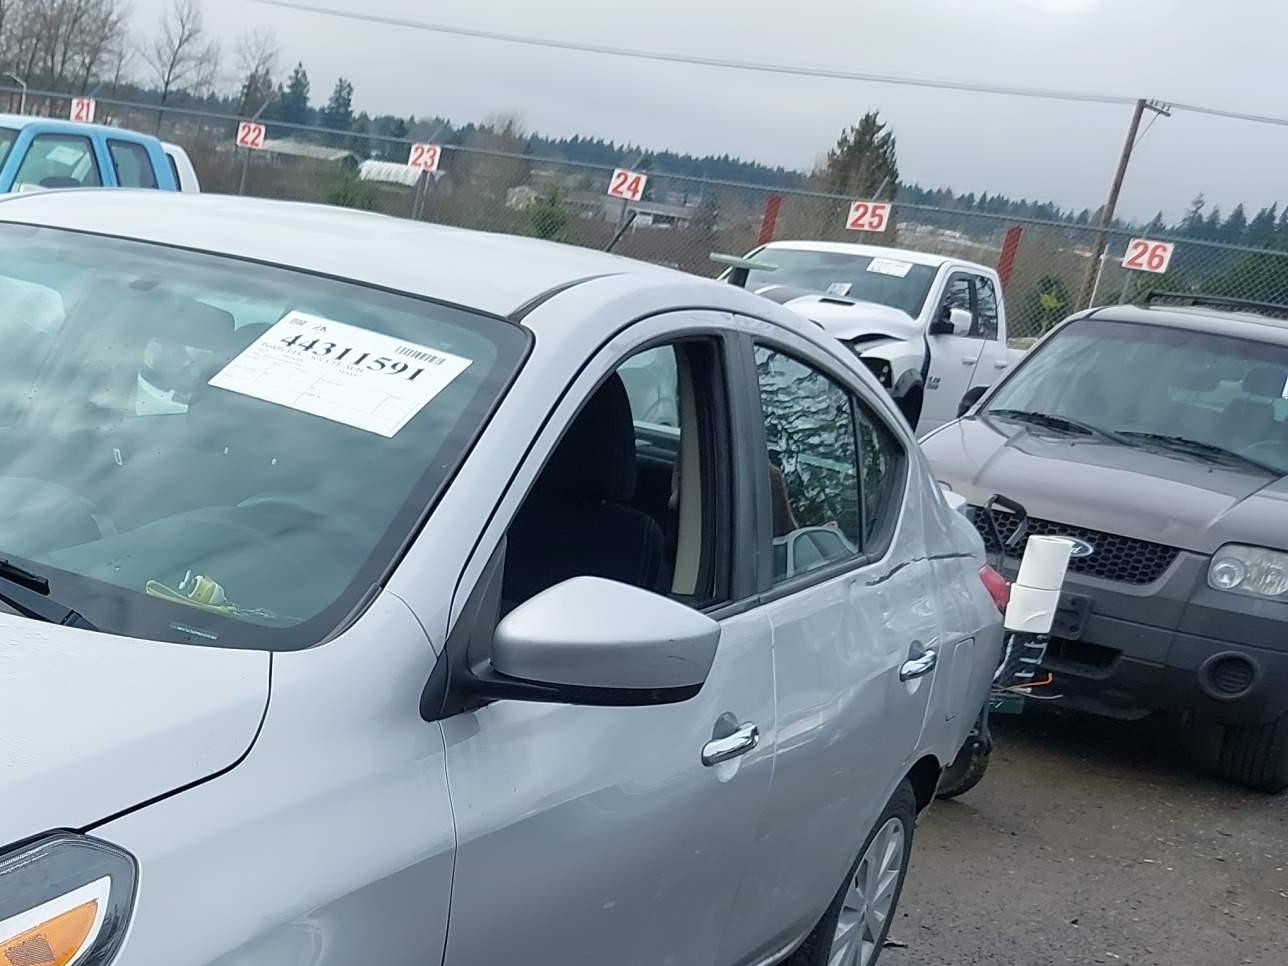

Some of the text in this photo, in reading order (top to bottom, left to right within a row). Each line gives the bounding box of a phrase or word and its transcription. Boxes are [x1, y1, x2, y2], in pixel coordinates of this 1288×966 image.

[74, 101, 91, 120] 21
[240, 123, 262, 147] 22
[410, 145, 437, 168] 23
[611, 171, 642, 198] 24
[849, 203, 886, 230] 25
[1127, 241, 1168, 271] 26
[280, 333, 426, 382] 44311591
